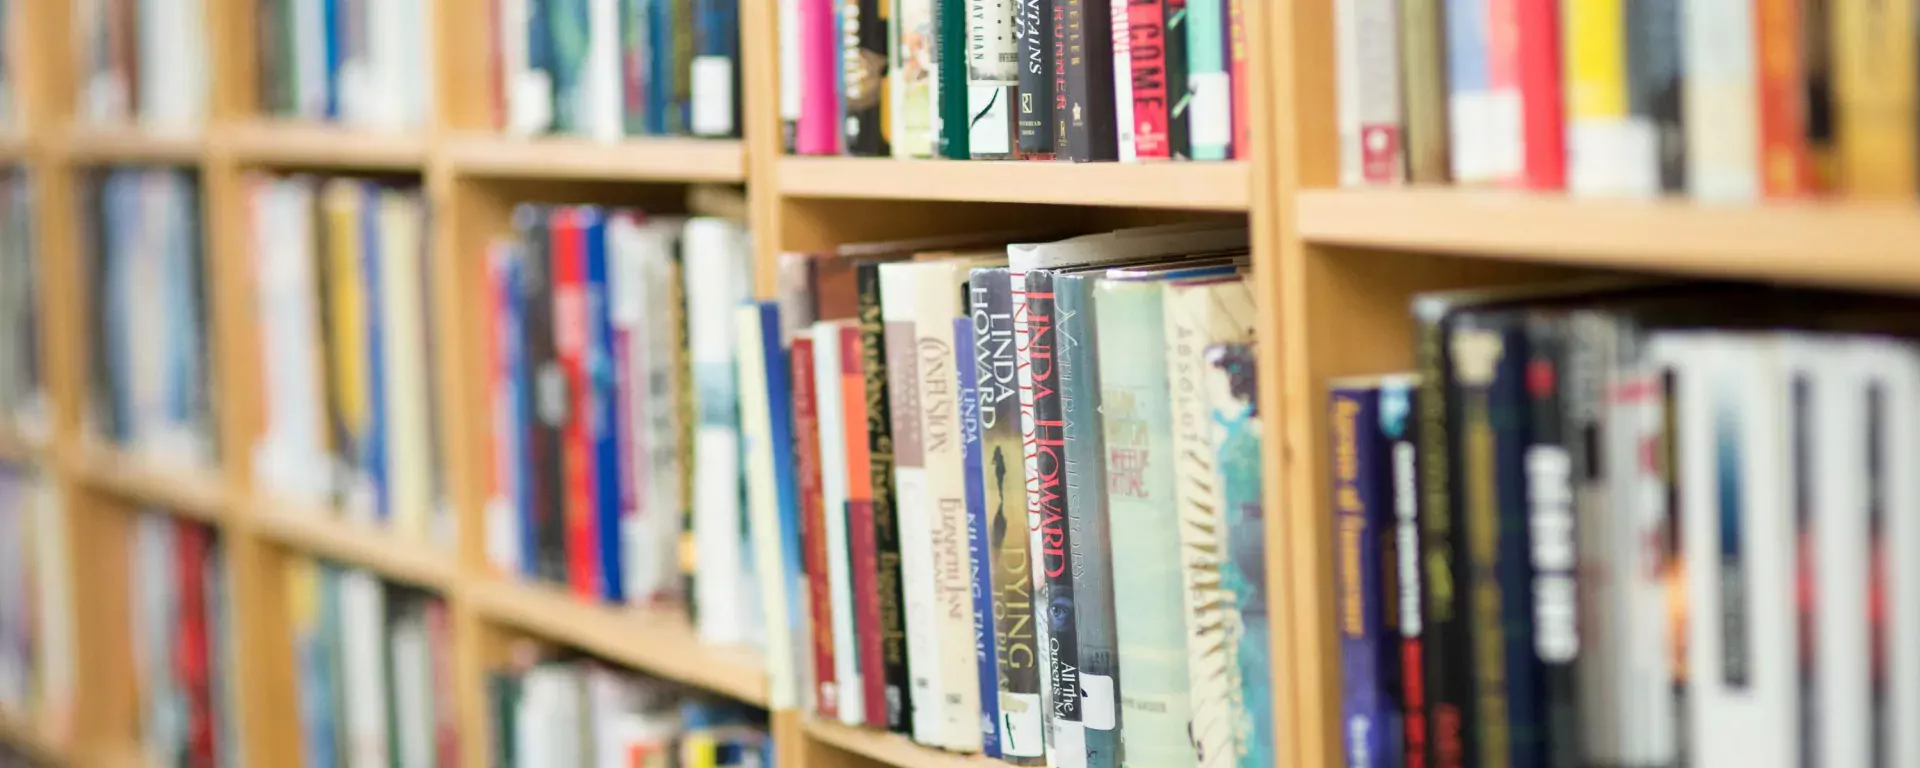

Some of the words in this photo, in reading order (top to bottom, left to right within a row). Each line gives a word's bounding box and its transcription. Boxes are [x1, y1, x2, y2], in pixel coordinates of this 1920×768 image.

[1053, 5, 1067, 109] RUNNER
[1131, 24, 1162, 108] COME
[917, 336, 952, 453] CONFUSION
[971, 287, 997, 429] HOWARD
[990, 313, 1016, 403] LINDA
[1025, 292, 1055, 401] LINDA
[1056, 305, 1077, 444] NATURAL
[963, 387, 978, 444] LINDA
[1035, 420, 1065, 578] HOWARD
[1066, 460, 1085, 587] HISTORY
[966, 513, 982, 599] KILLING
[974, 609, 987, 662] TIME
[1001, 547, 1034, 669] DYING
[1049, 637, 1061, 696] Queen's
[1060, 662, 1076, 682] All
[1062, 686, 1078, 712] The
